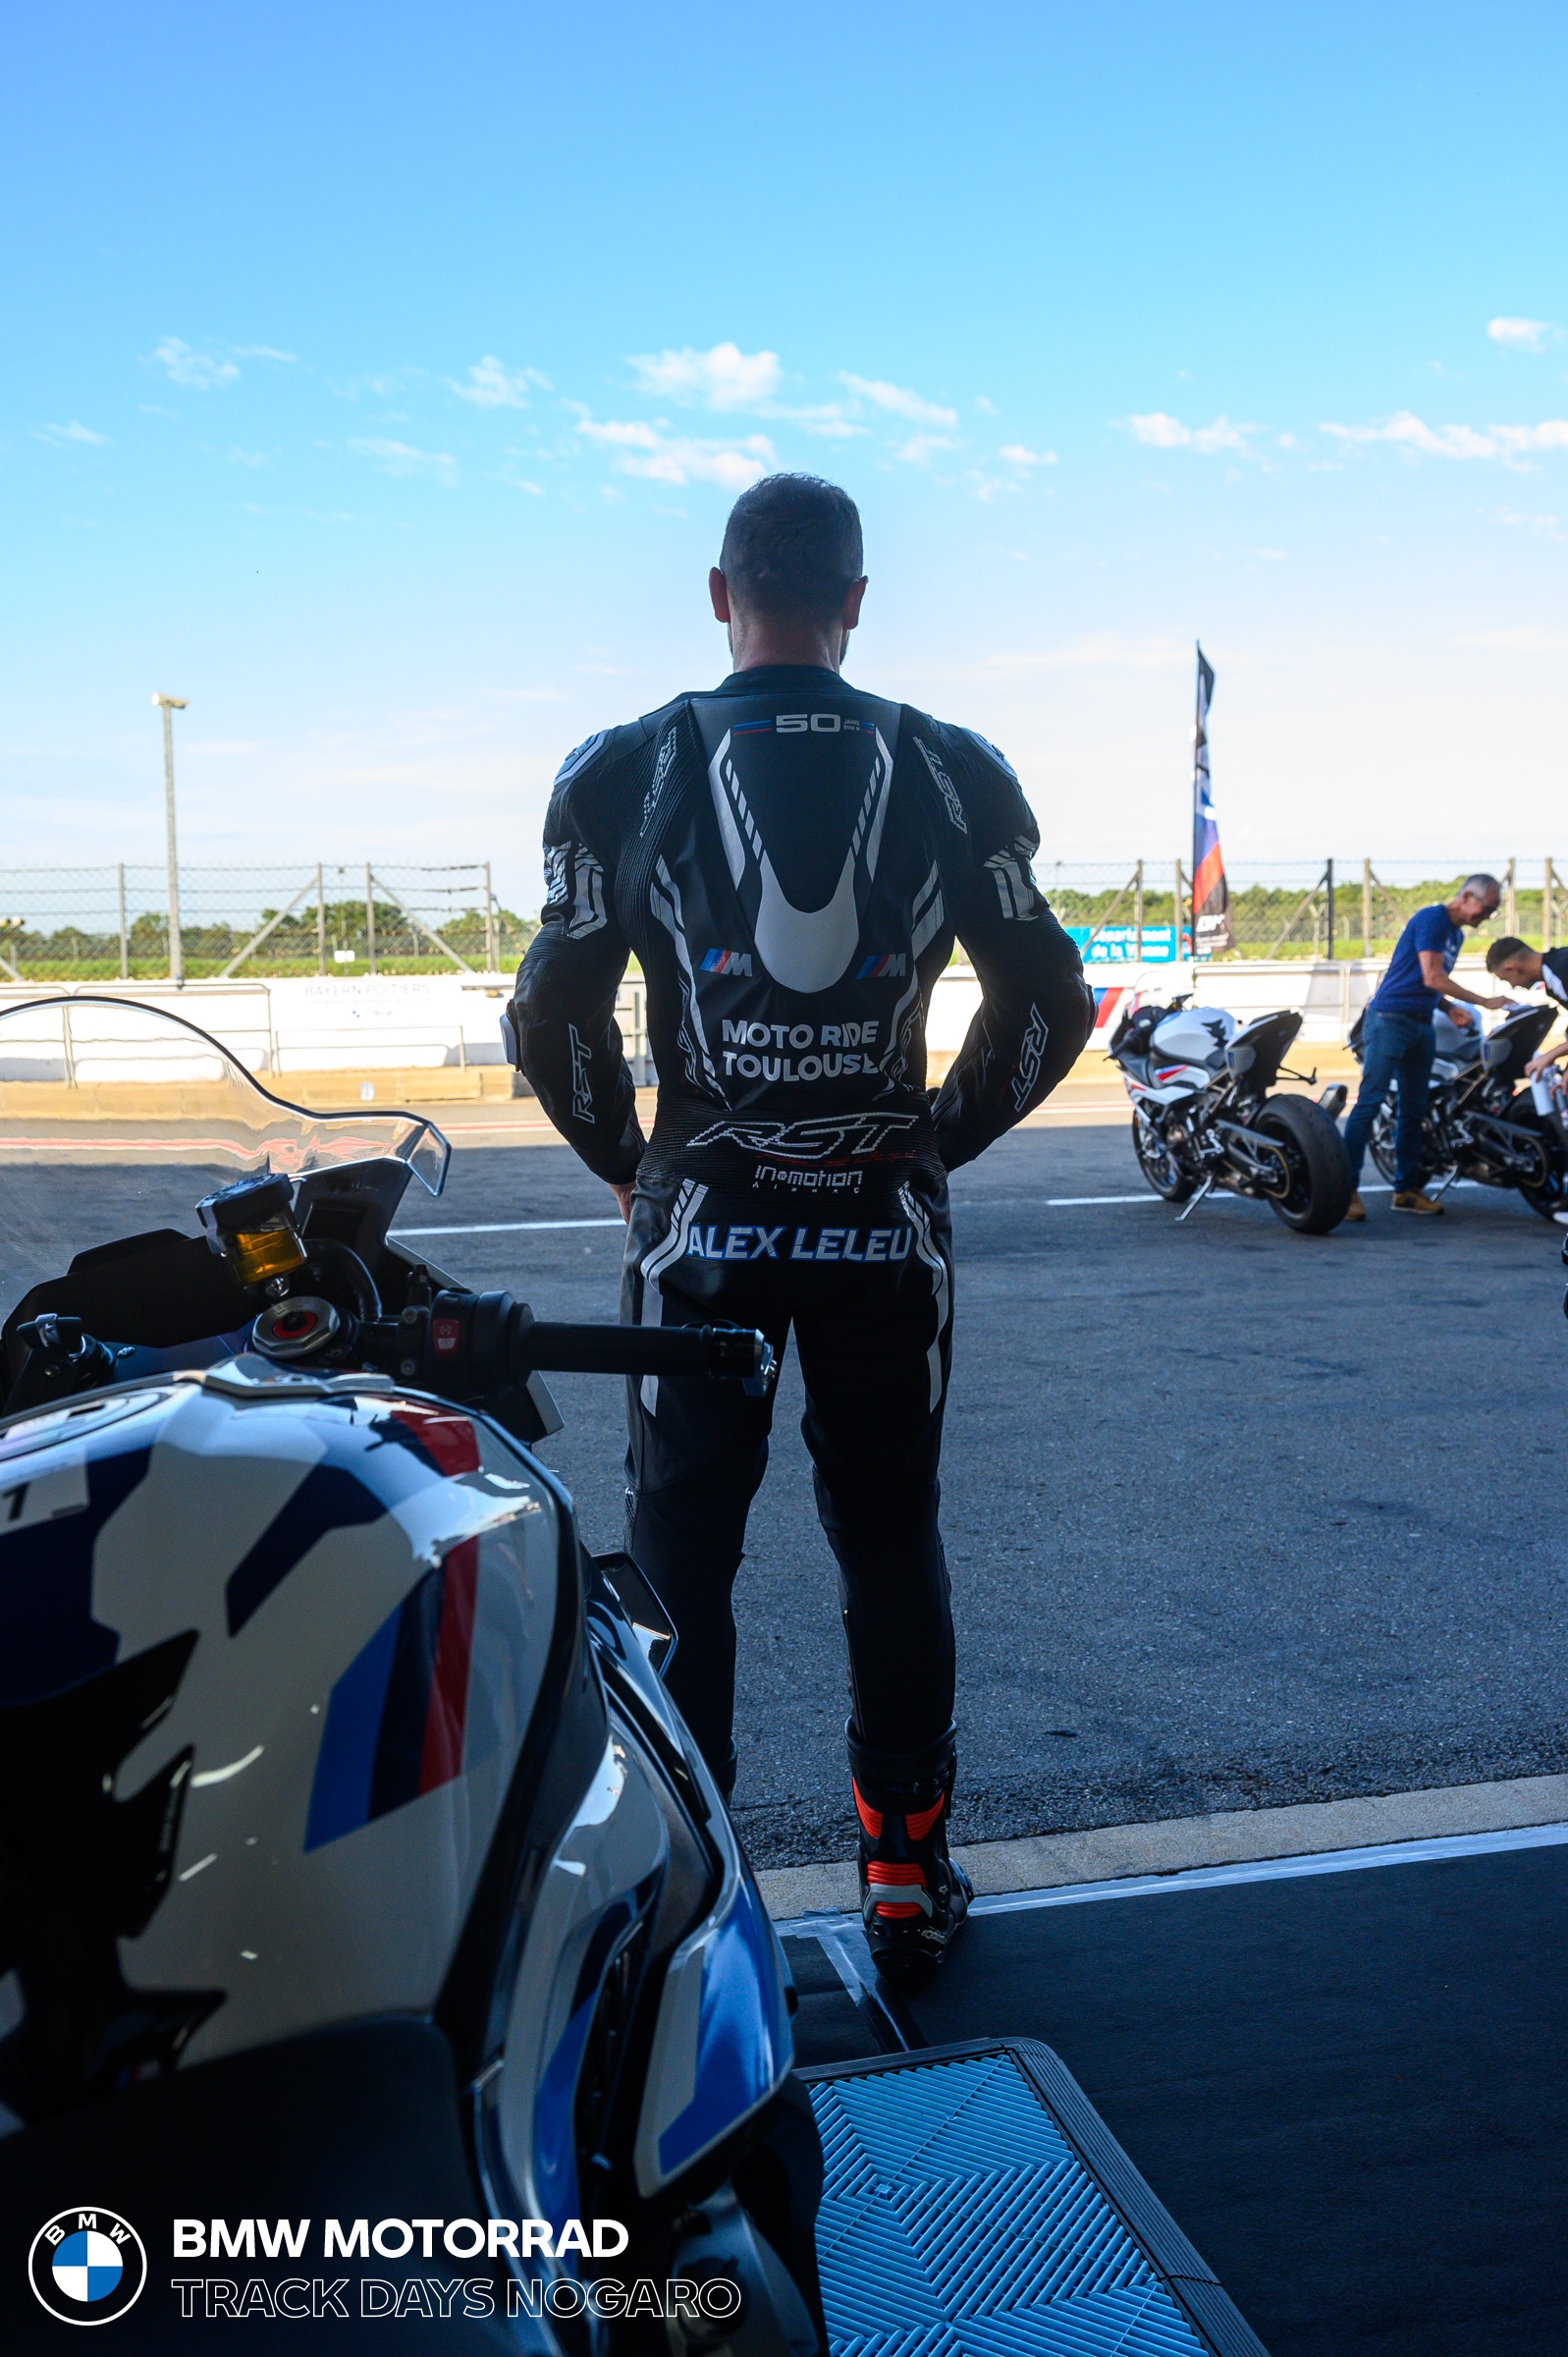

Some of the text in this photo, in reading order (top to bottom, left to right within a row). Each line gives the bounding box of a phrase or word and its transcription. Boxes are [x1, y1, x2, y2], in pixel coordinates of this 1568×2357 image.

[776, 713, 841, 734] 50
[722, 1019, 879, 1049] MOTO RIDE
[568, 1022, 595, 1124] RST
[1011, 1002, 1049, 1112] RST
[685, 1112, 919, 1160] RST
[687, 1226, 912, 1261] ALEX LELEU
